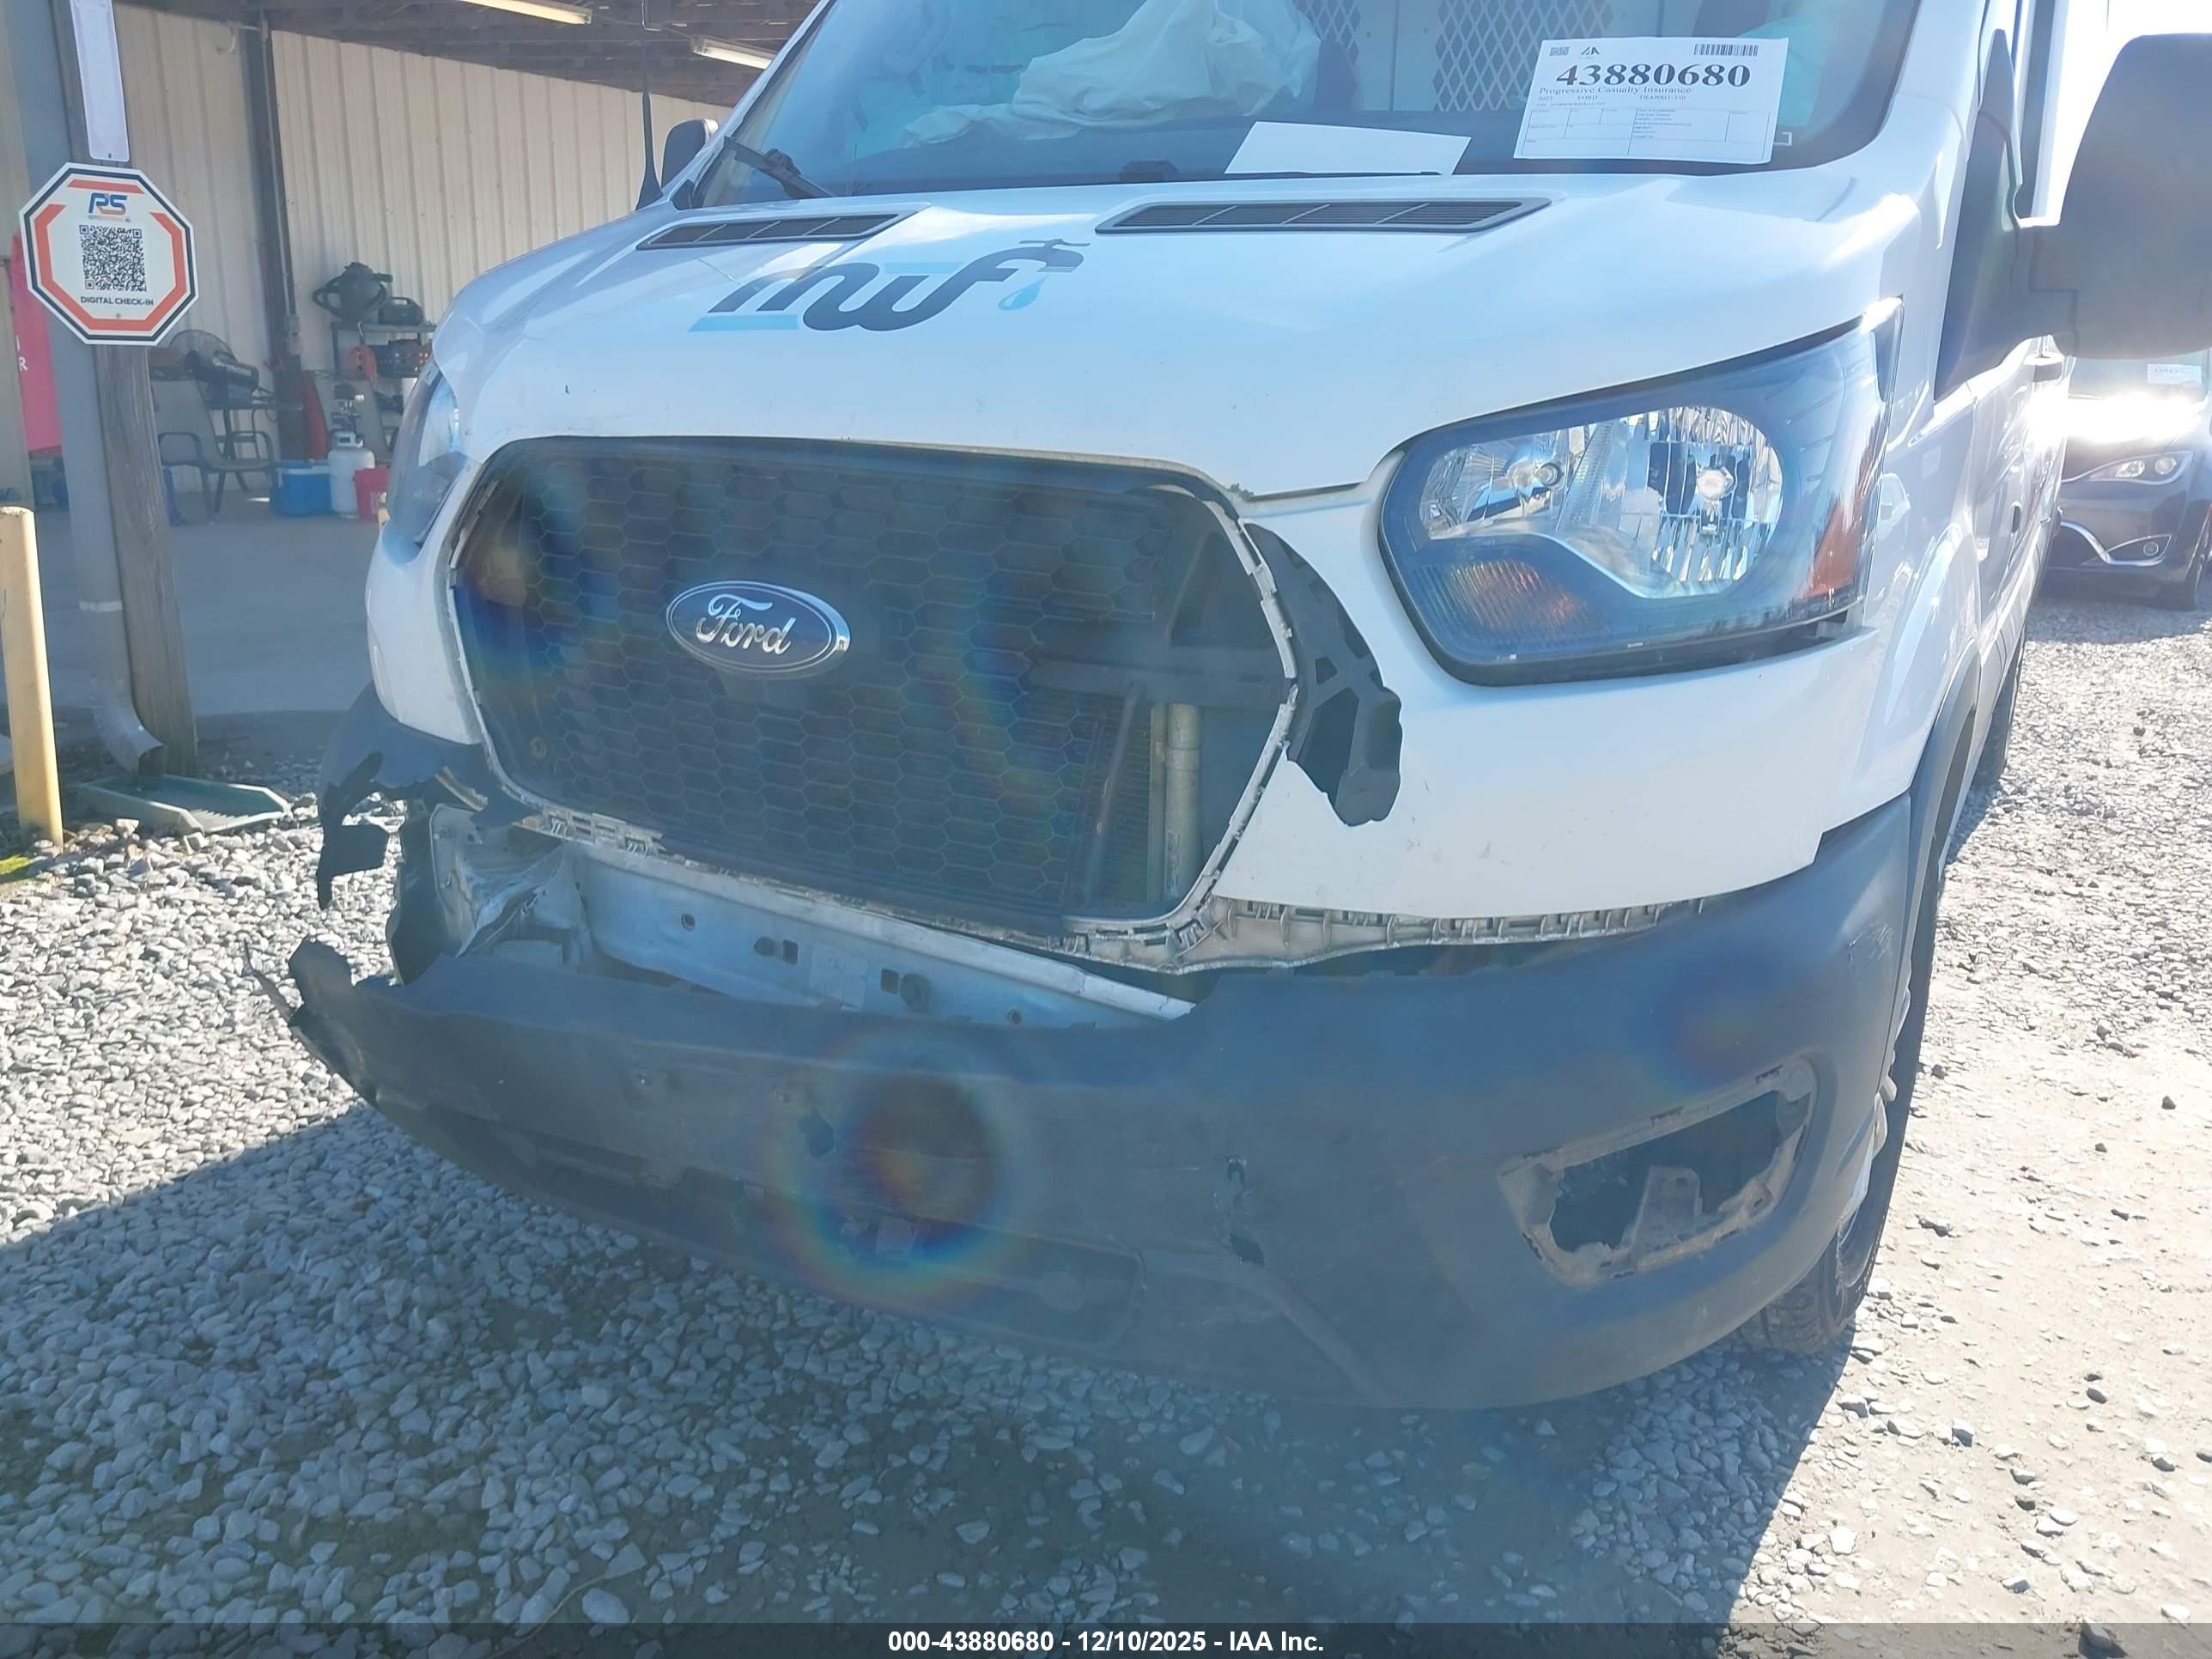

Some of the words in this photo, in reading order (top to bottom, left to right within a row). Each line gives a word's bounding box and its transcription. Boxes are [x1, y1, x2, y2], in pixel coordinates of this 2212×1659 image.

[1556, 63, 1751, 87] 43880680
[1598, 86, 1640, 94] Casualty
[81, 296, 113, 305] DIGITAL
[696, 593, 797, 655] Ford
